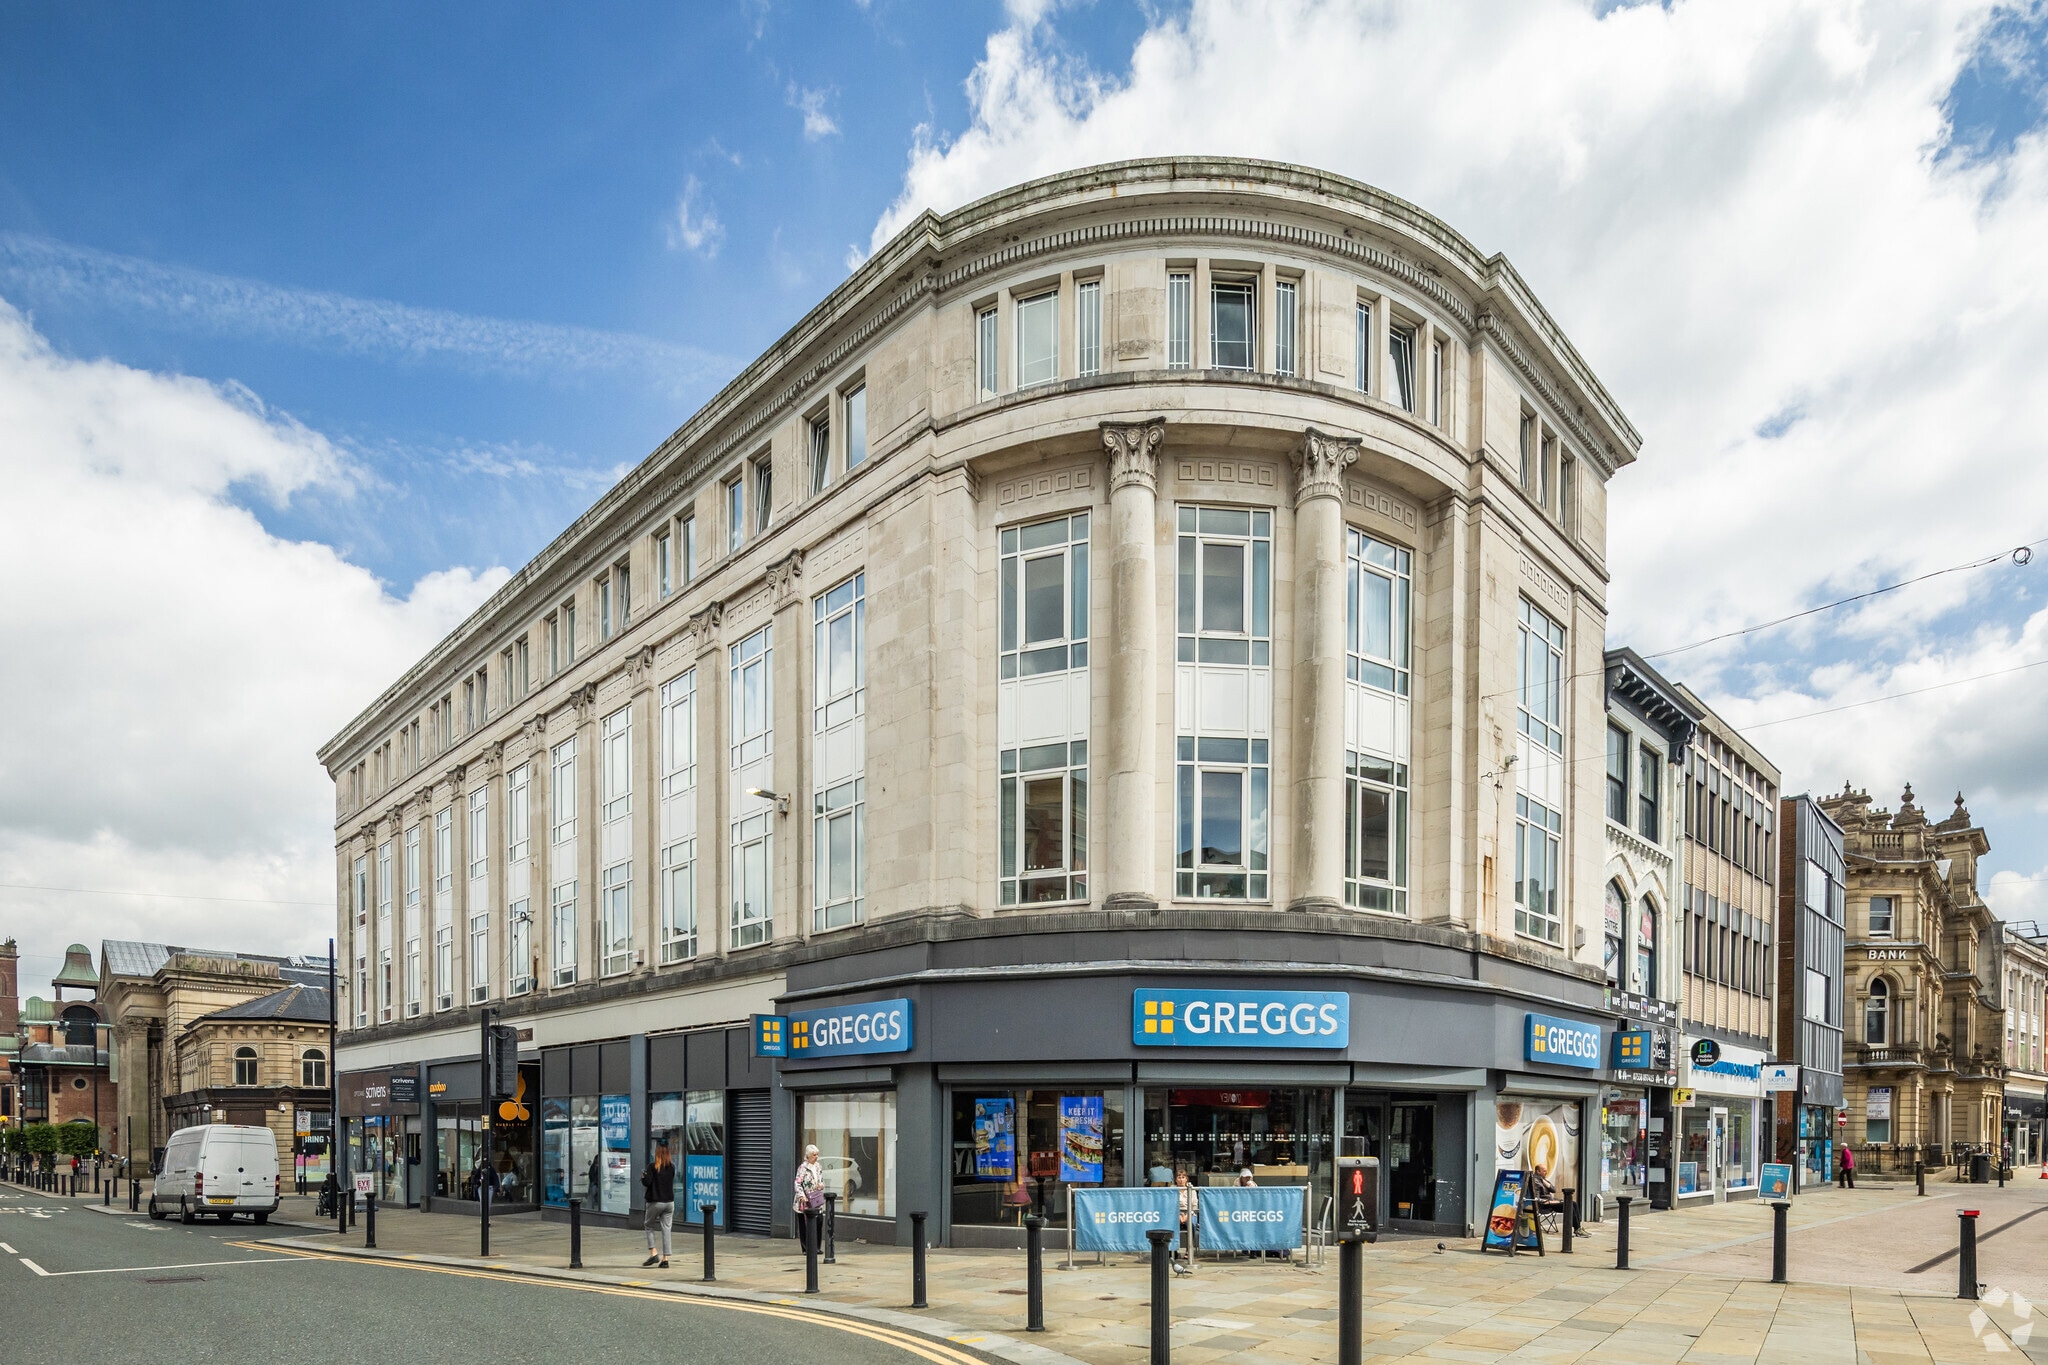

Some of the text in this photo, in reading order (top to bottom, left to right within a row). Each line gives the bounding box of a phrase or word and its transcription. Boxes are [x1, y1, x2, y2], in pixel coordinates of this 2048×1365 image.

[1868, 949, 1907, 960] BANK
[1184, 1001, 1338, 1035] GREGGS
[812, 1010, 901, 1047] GREGGS
[1548, 1026, 1598, 1060] GREGGS
[365, 1083, 387, 1099] scrivens
[604, 1102, 630, 1118] TO LET
[1068, 1107, 1095, 1116] KEEP IT
[985, 1113, 1005, 1140] BIG
[1071, 1116, 1093, 1125] FRESH
[305, 1135, 325, 1143] BRING
[693, 1166, 719, 1179] PRIME
[357, 1179, 371, 1187] EYE
[693, 1182, 719, 1196] SPACE
[693, 1198, 704, 1212] TO
[1108, 1210, 1160, 1224] GREGGS
[1231, 1210, 1284, 1223] GREGGS
